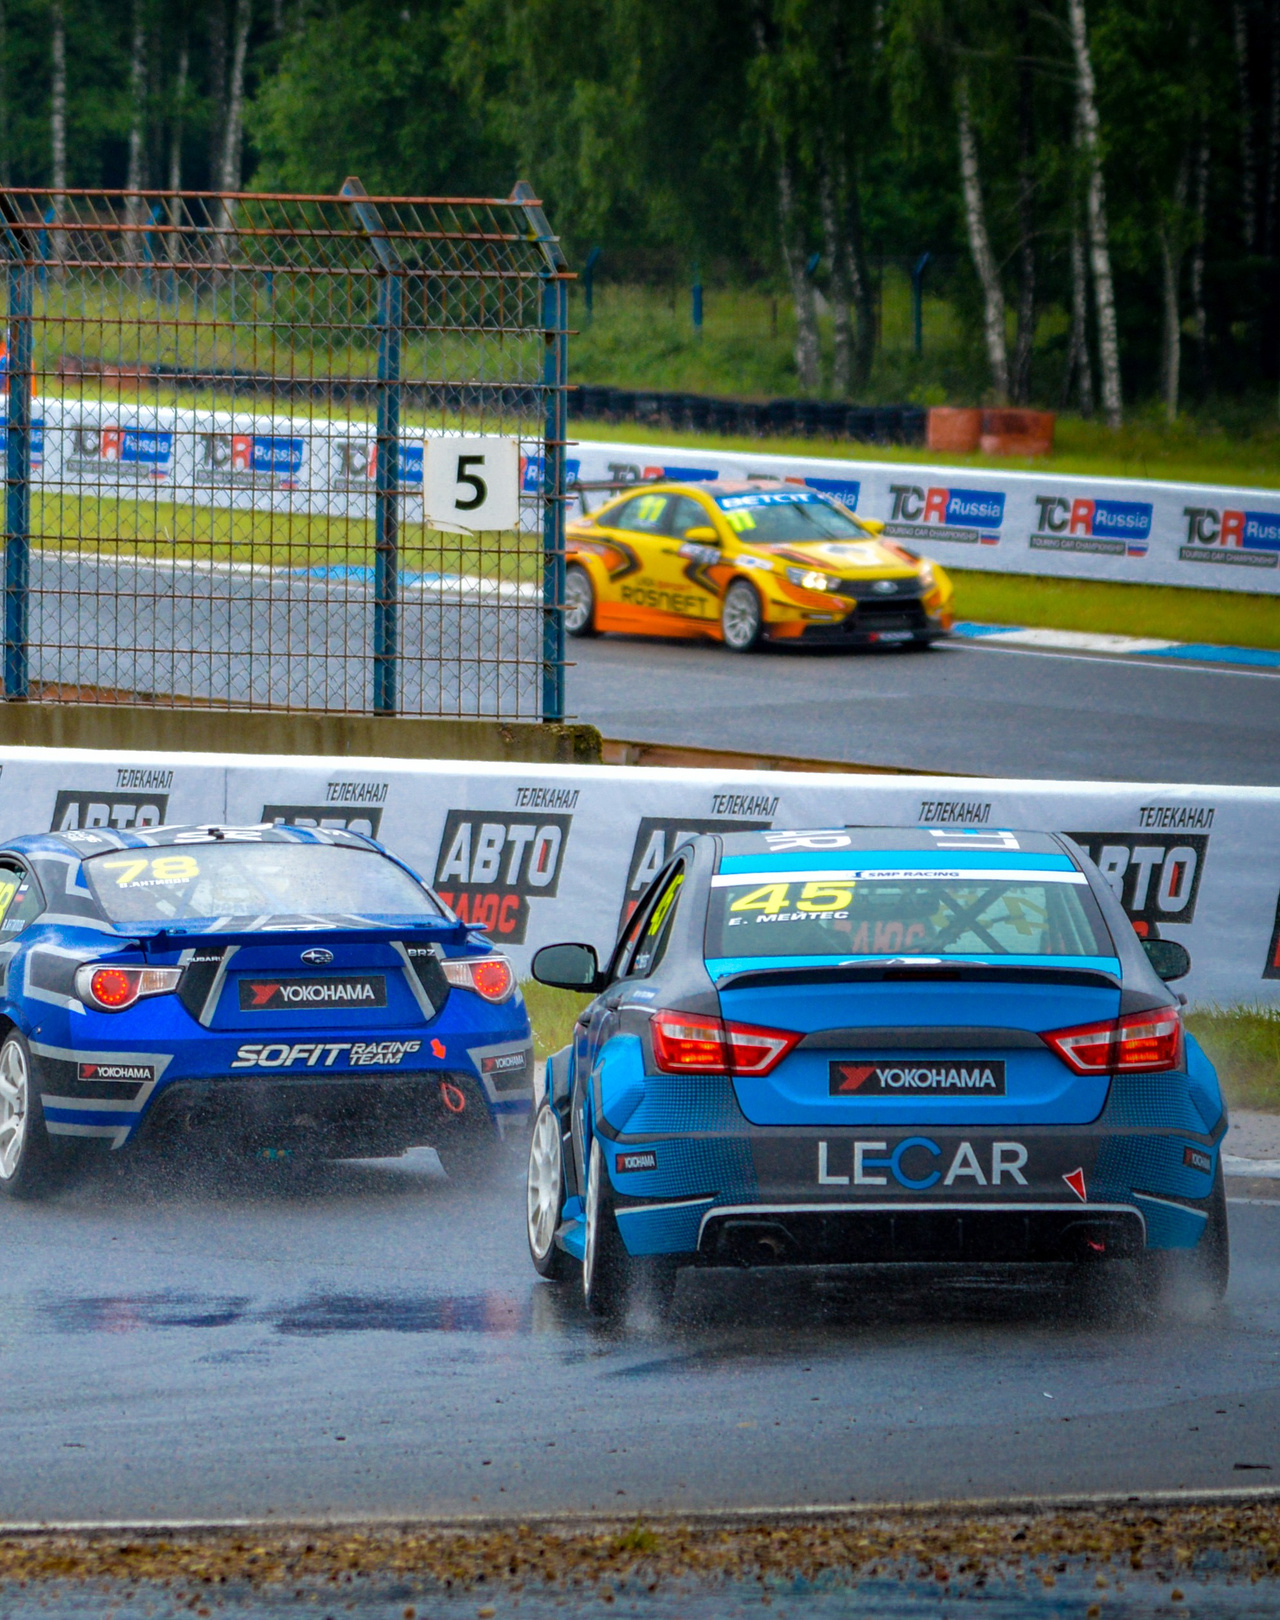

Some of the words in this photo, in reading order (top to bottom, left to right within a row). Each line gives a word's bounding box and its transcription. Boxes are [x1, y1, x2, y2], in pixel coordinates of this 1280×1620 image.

[455, 455, 488, 511] 5
[637, 495, 667, 522] 11
[889, 484, 949, 523] TCR
[949, 498, 1001, 518] Russia
[727, 510, 757, 532] 11
[1035, 495, 1096, 535] TCR
[1095, 509, 1148, 528] Russia
[1183, 506, 1246, 547] TCR
[116, 769, 174, 789] ТЕЛЕКАНАЛ
[326, 783, 388, 802] ТЕЛЕКАНАЛ
[516, 788, 580, 808] ТЕЛЕКАНАЛ
[712, 794, 780, 816] ТЕЛЕКАНАЛ
[918, 801, 991, 823] ТЕЛЕКАНАЛ
[1139, 807, 1215, 829] ТЕЛЕКАНАЛ
[439, 823, 562, 887] АВТО
[103, 856, 200, 885] 78
[1079, 845, 1197, 912] ВТО
[730, 881, 856, 914] 45
[756, 909, 850, 924] МЕЙТЕС
[408, 949, 436, 957] BRZ
[280, 983, 376, 1002] YOKOHAMA
[230, 1043, 352, 1068] SOFIT
[350, 1040, 422, 1053] RACING
[349, 1053, 404, 1065] TEAM
[495, 1055, 524, 1069] YOKOHAMA
[97, 1066, 151, 1079] YOKOHAMA
[876, 1068, 996, 1088] YOKOHAMA
[818, 1136, 1029, 1190] LECAR
